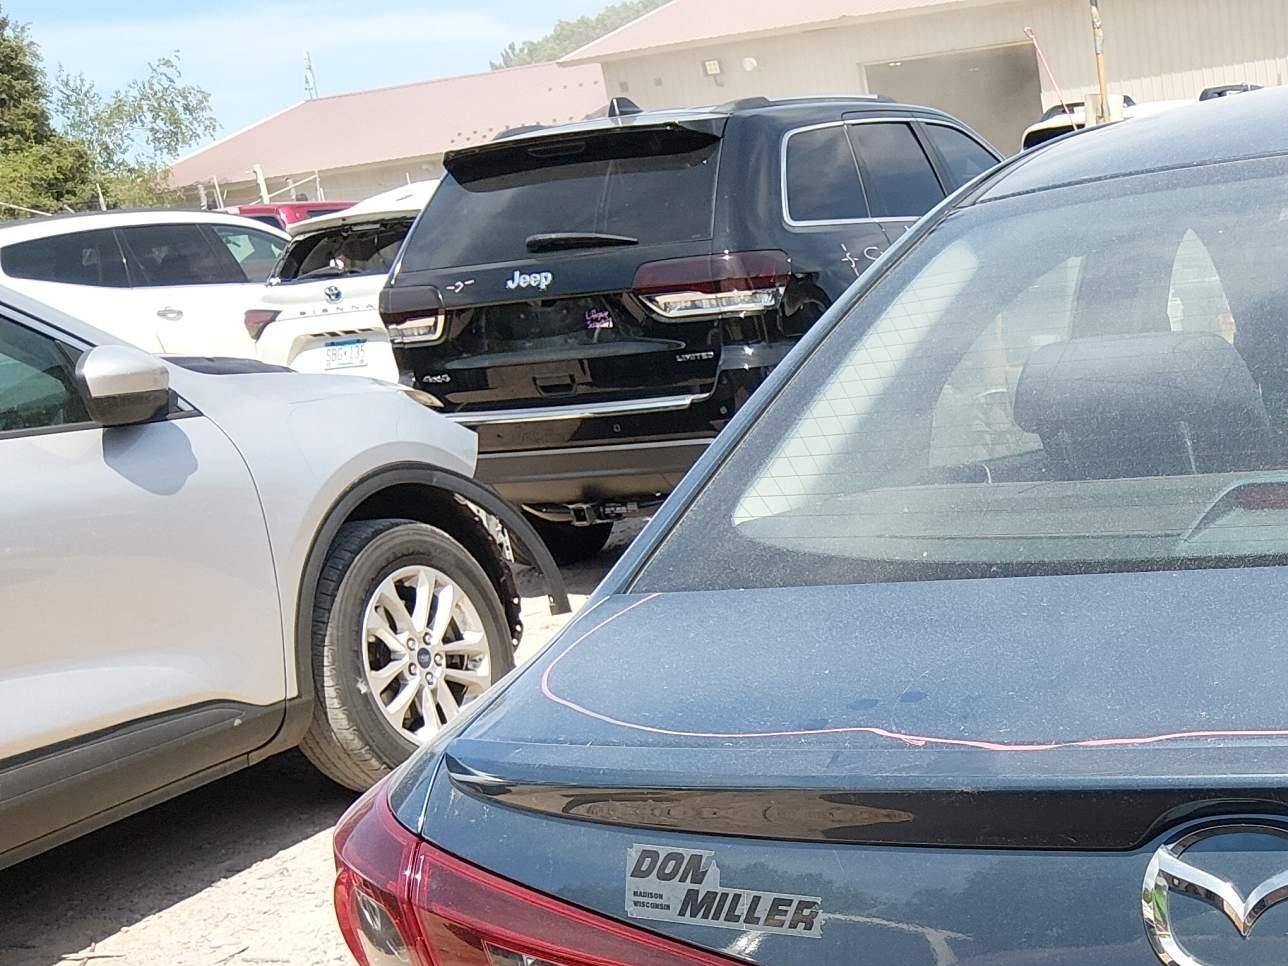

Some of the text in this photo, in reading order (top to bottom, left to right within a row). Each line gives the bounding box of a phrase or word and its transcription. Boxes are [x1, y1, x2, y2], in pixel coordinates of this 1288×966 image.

[505, 270, 553, 291] Jeep
[630, 848, 709, 885] DON
[632, 900, 671, 911] WISCONSIN
[633, 890, 664, 900] MADISON
[678, 888, 819, 931] MILLER
